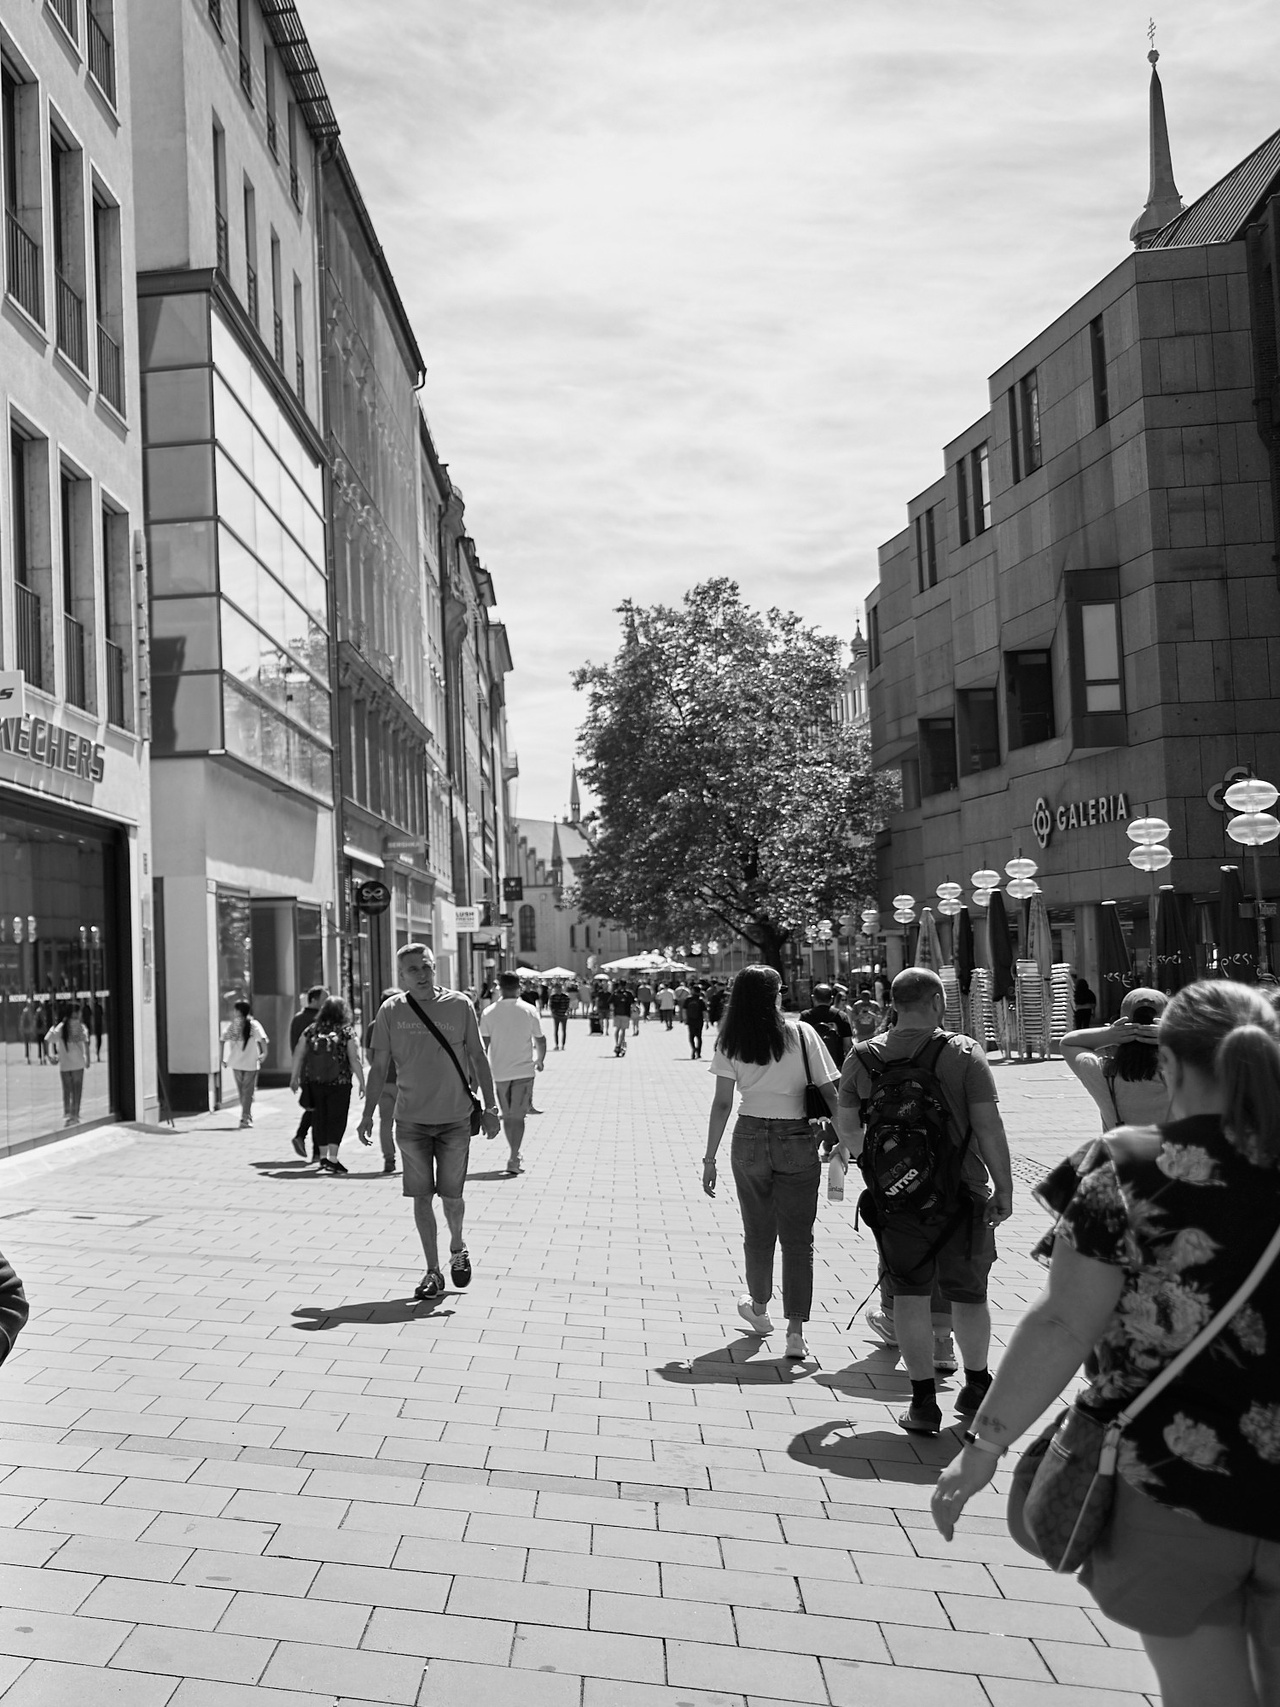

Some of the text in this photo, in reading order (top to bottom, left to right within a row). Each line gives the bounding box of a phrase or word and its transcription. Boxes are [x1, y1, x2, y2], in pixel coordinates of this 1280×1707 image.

[1056, 793, 1128, 831] GALERIA
[397, 1021, 422, 1029] Marc
[885, 1168, 918, 1197] NITRO
